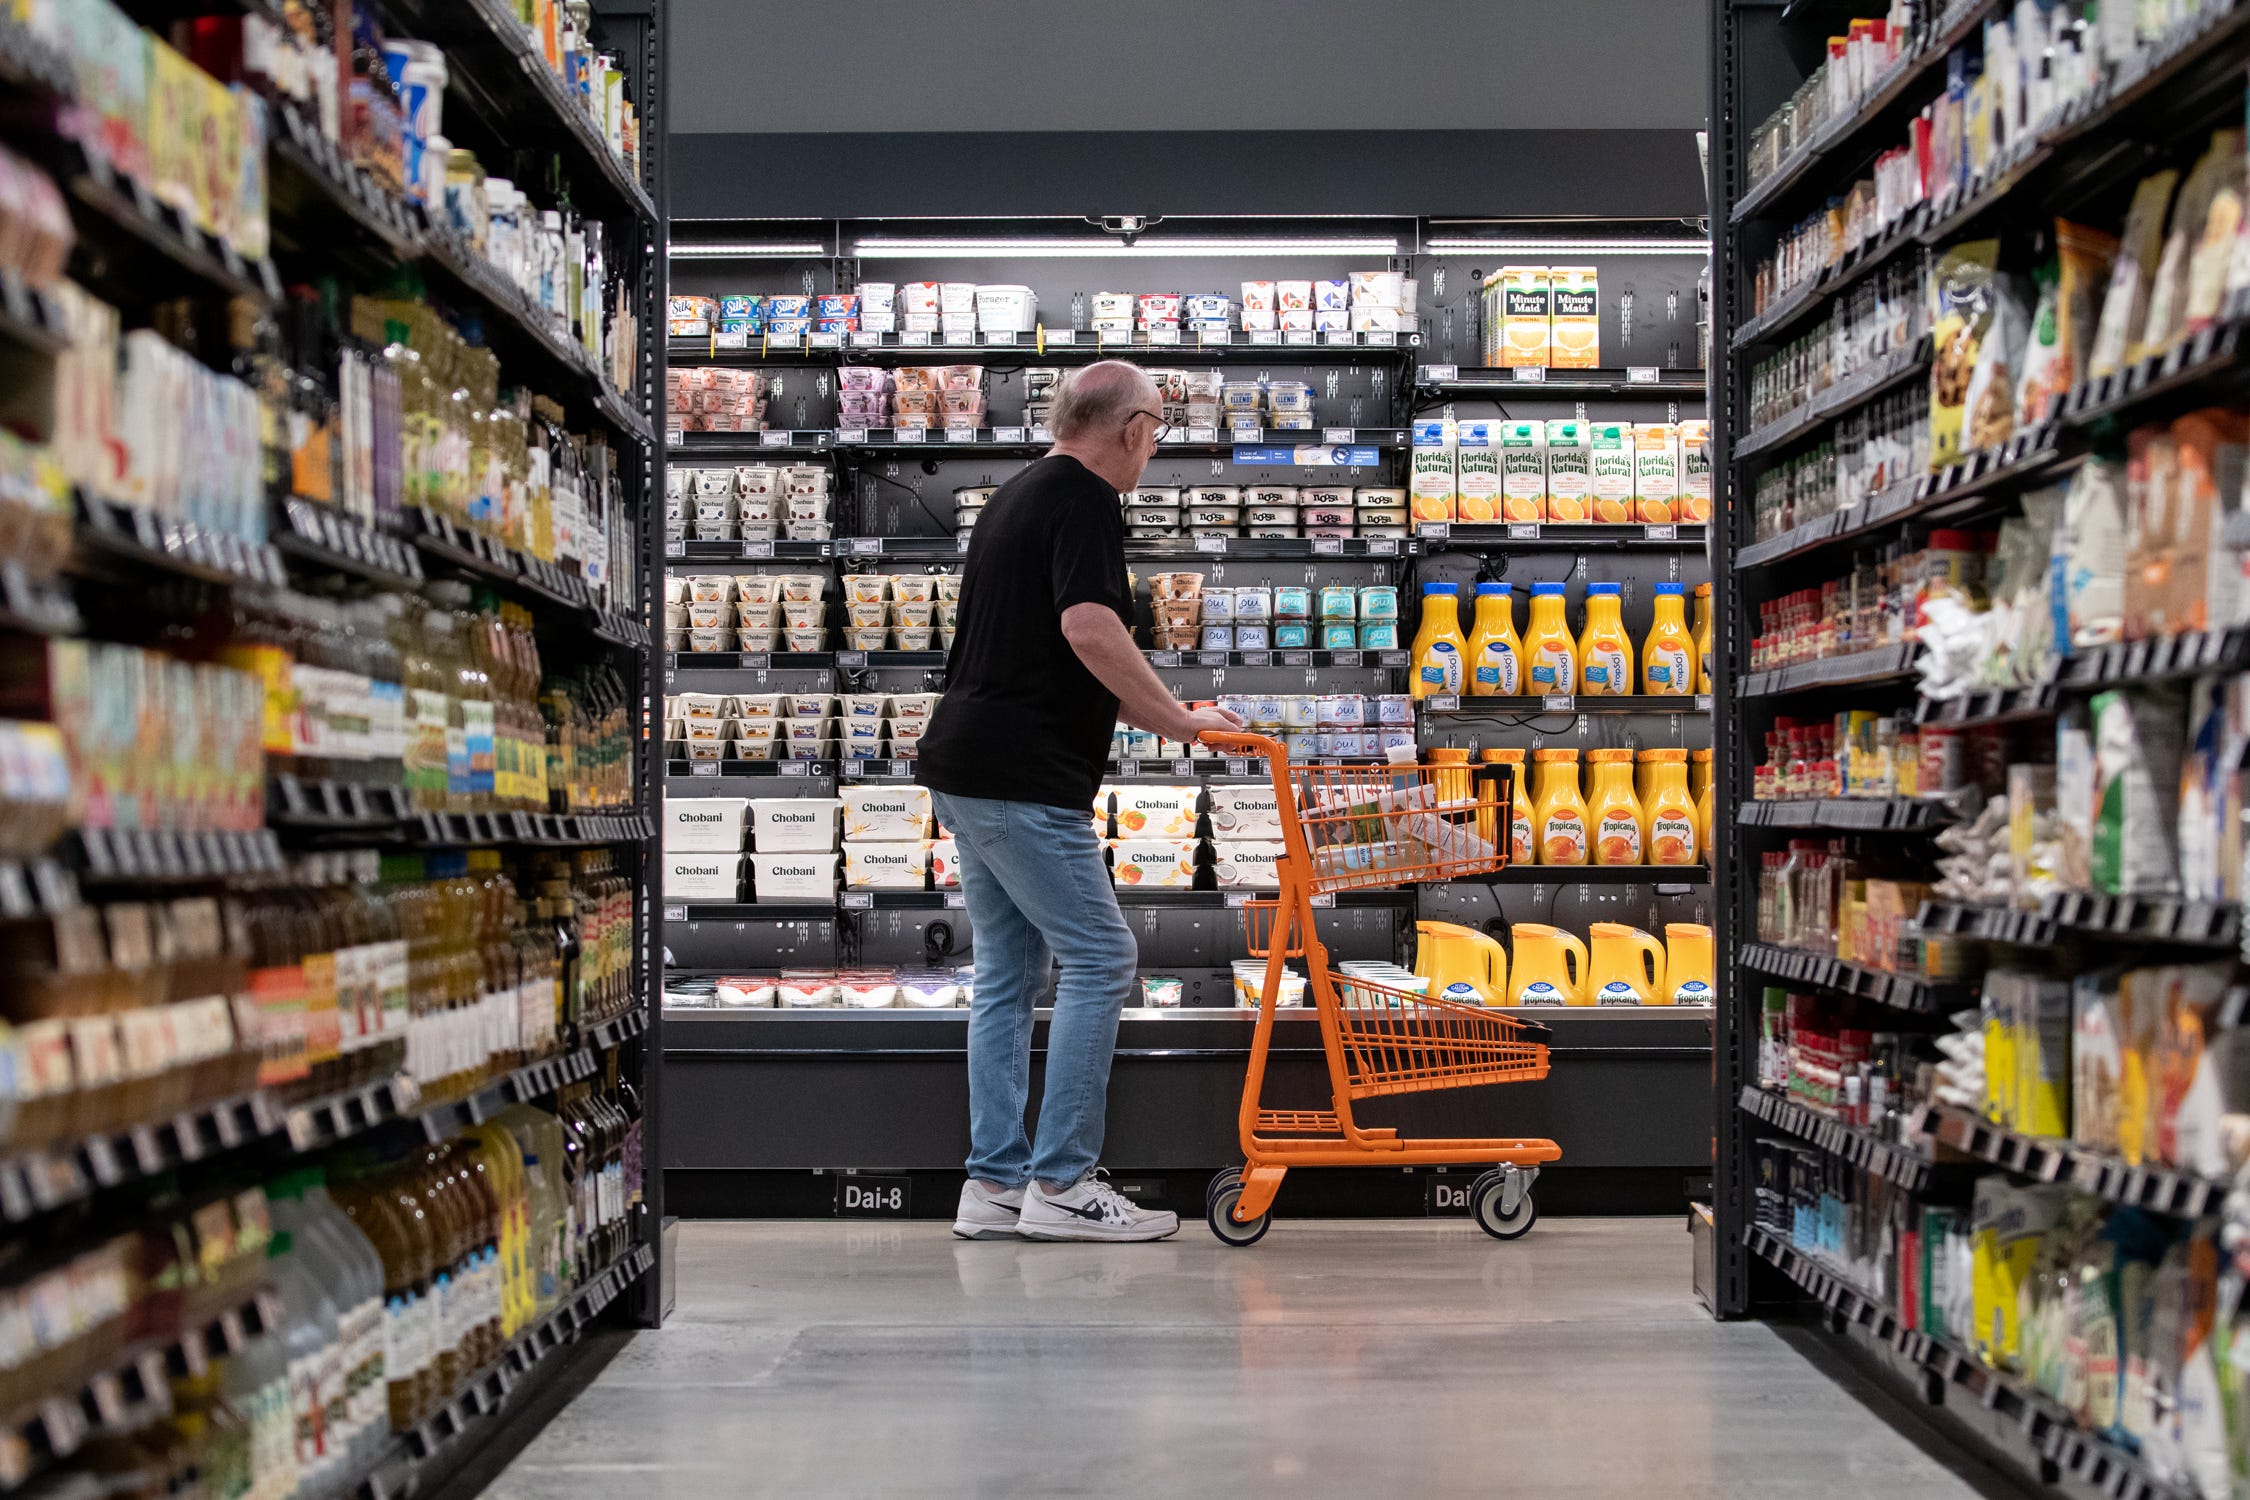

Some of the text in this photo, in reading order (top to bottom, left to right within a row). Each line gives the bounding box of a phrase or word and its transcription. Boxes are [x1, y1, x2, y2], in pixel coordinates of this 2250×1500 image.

[978, 295, 1010, 305] Forager
[1510, 294, 1545, 304] Minute
[1558, 294, 1593, 304] Minute
[672, 301, 690, 314] Silk
[727, 300, 745, 313] Silk
[775, 300, 794, 313] Silk
[824, 300, 844, 313] Silk
[1515, 303, 1541, 312] Maid
[1562, 303, 1589, 312] Maid
[1409, 334, 1420, 345] G
[818, 434, 826, 446] F
[1396, 432, 1404, 443] F
[1416, 452, 1452, 464] Florida's
[1461, 452, 1498, 464] Florida's
[1506, 452, 1542, 465] Florida's
[1551, 452, 1587, 464] Florida's
[1595, 455, 1631, 467] Florida's
[1639, 455, 1675, 467] Florida's
[1416, 463, 1451, 474] Natural
[1461, 463, 1497, 474] Natural
[1506, 463, 1541, 475] Natural
[1551, 463, 1587, 475] Natural
[1595, 467, 1630, 477] Natural
[1639, 467, 1674, 477] Natural
[1687, 464, 1709, 475] Natu
[1139, 494, 1163, 503] noosa
[1201, 493, 1226, 501] noosa
[1258, 493, 1283, 501] noosa
[1314, 494, 1339, 503] noosa
[1368, 496, 1393, 504] noosa
[1141, 514, 1166, 522] noosa
[1200, 513, 1225, 521] noosa
[1253, 512, 1276, 521] noosa
[1316, 514, 1341, 522] noosa
[1367, 515, 1391, 523] noosa
[822, 545, 830, 556] E
[1409, 543, 1418, 553] E
[1207, 598, 1227, 607] oui
[1240, 598, 1261, 608] oui
[1210, 631, 1228, 640] oui
[1242, 631, 1262, 641] oui
[1261, 705, 1279, 714] oui
[1337, 705, 1357, 715] oui
[1382, 706, 1401, 717] oui
[1337, 739, 1356, 749] oui
[812, 764, 822, 775] C
[862, 803, 906, 812] Chobani
[1135, 800, 1179, 809] Chobani
[1234, 800, 1277, 810] Chobani
[679, 813, 723, 822] Chobani
[772, 813, 815, 822] Chobani
[1549, 821, 1582, 832] Tropicana
[1603, 821, 1636, 832] Tropicana
[1657, 821, 1689, 832] Tropicana
[864, 855, 908, 864] Chobani
[1132, 853, 1175, 863] Chobani
[675, 866, 719, 875] Chobani
[772, 866, 816, 876] Chobani
[1524, 994, 1561, 1005] Tropicana
[1600, 993, 1638, 1005] Tropicana
[845, 1185, 902, 1210] Dai-8
[1436, 1185, 1471, 1207] Dai
